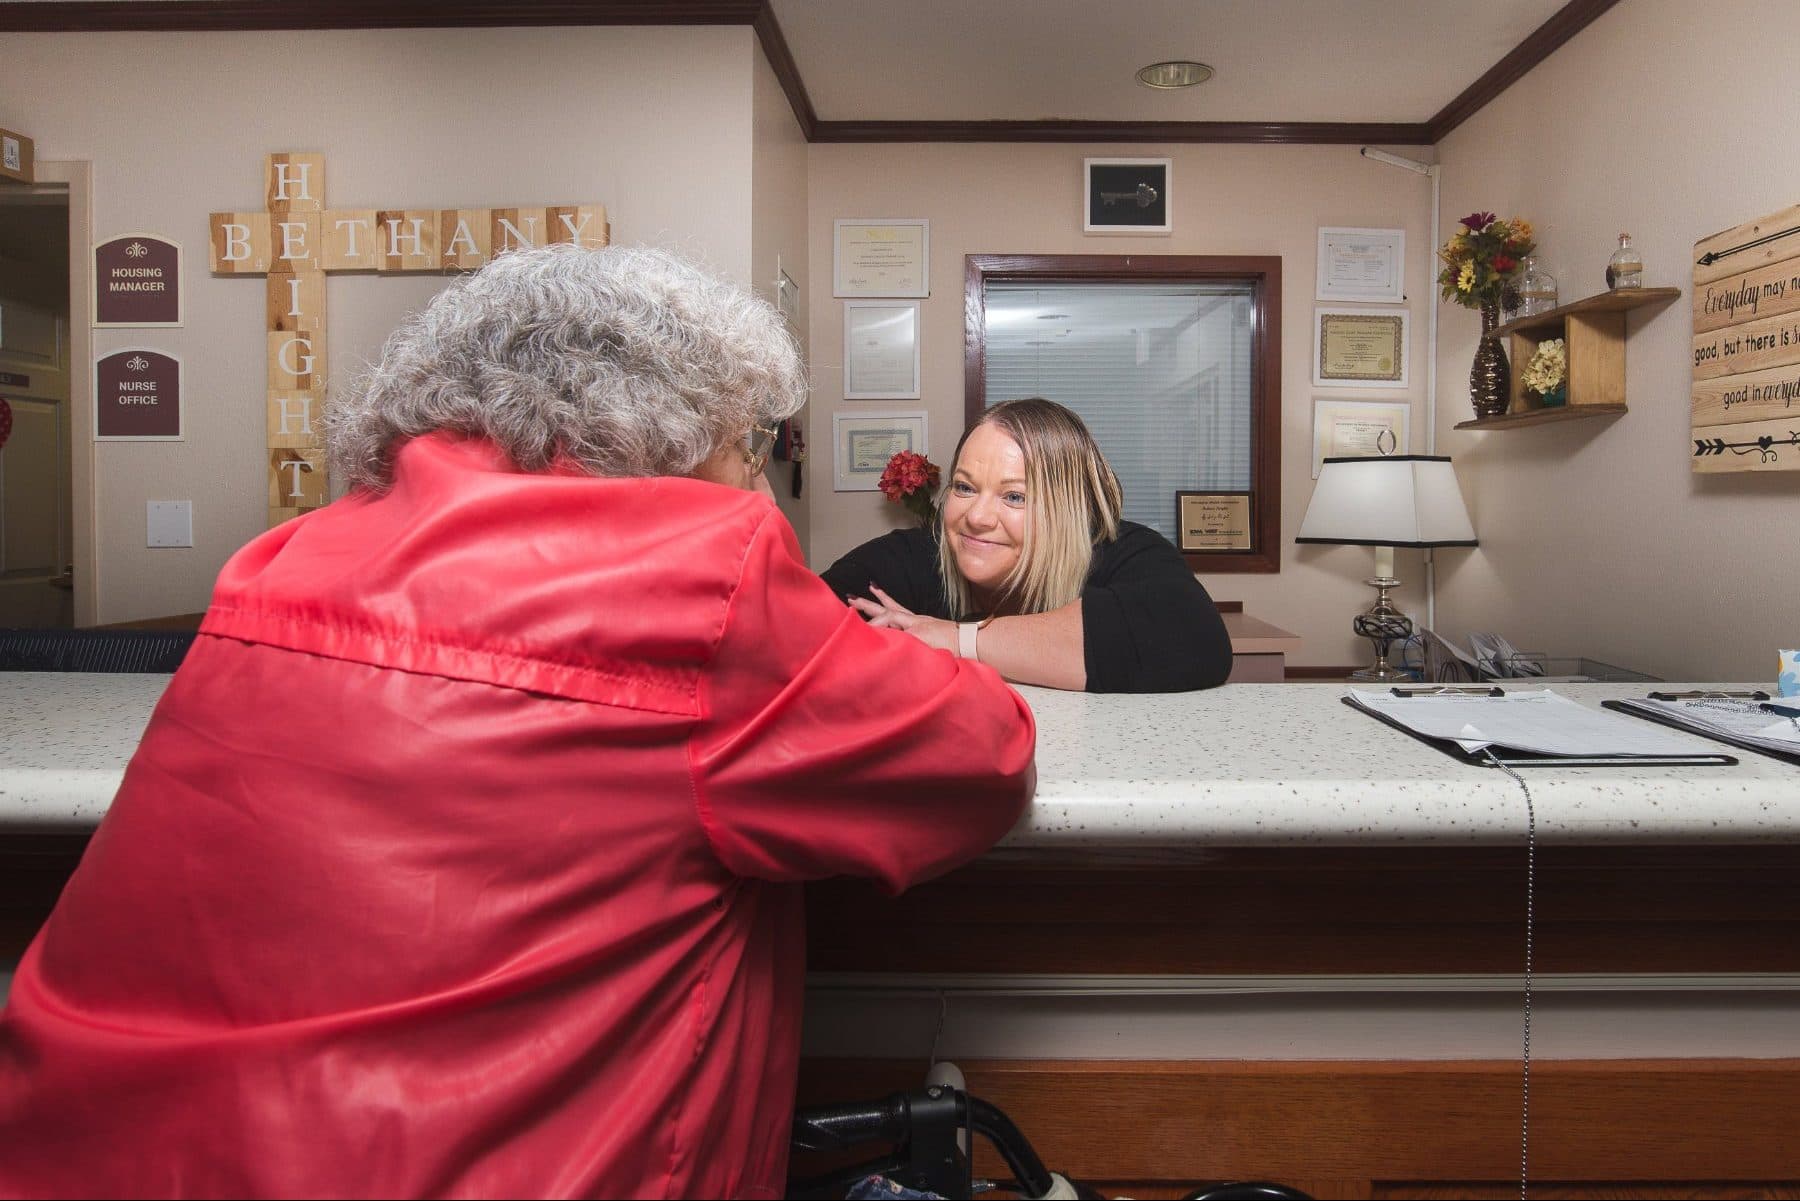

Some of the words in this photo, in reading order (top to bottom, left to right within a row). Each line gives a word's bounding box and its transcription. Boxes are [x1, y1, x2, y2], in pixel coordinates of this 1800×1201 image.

[221, 213, 593, 262] BETHANY
[111, 267, 163, 278] HOUSING
[109, 282, 165, 292] MANAGER
[1704, 279, 1760, 319] Everyday
[1763, 280, 1786, 299] may
[1791, 277, 1800, 291] n
[1694, 340, 1720, 367] good,
[1724, 336, 1741, 356] but
[1746, 333, 1776, 353] there
[1780, 327, 1789, 346] is
[119, 381, 157, 391] NURSE
[118, 395, 158, 405] OFFICE
[1723, 383, 1748, 410] good
[1752, 383, 1761, 401] in
